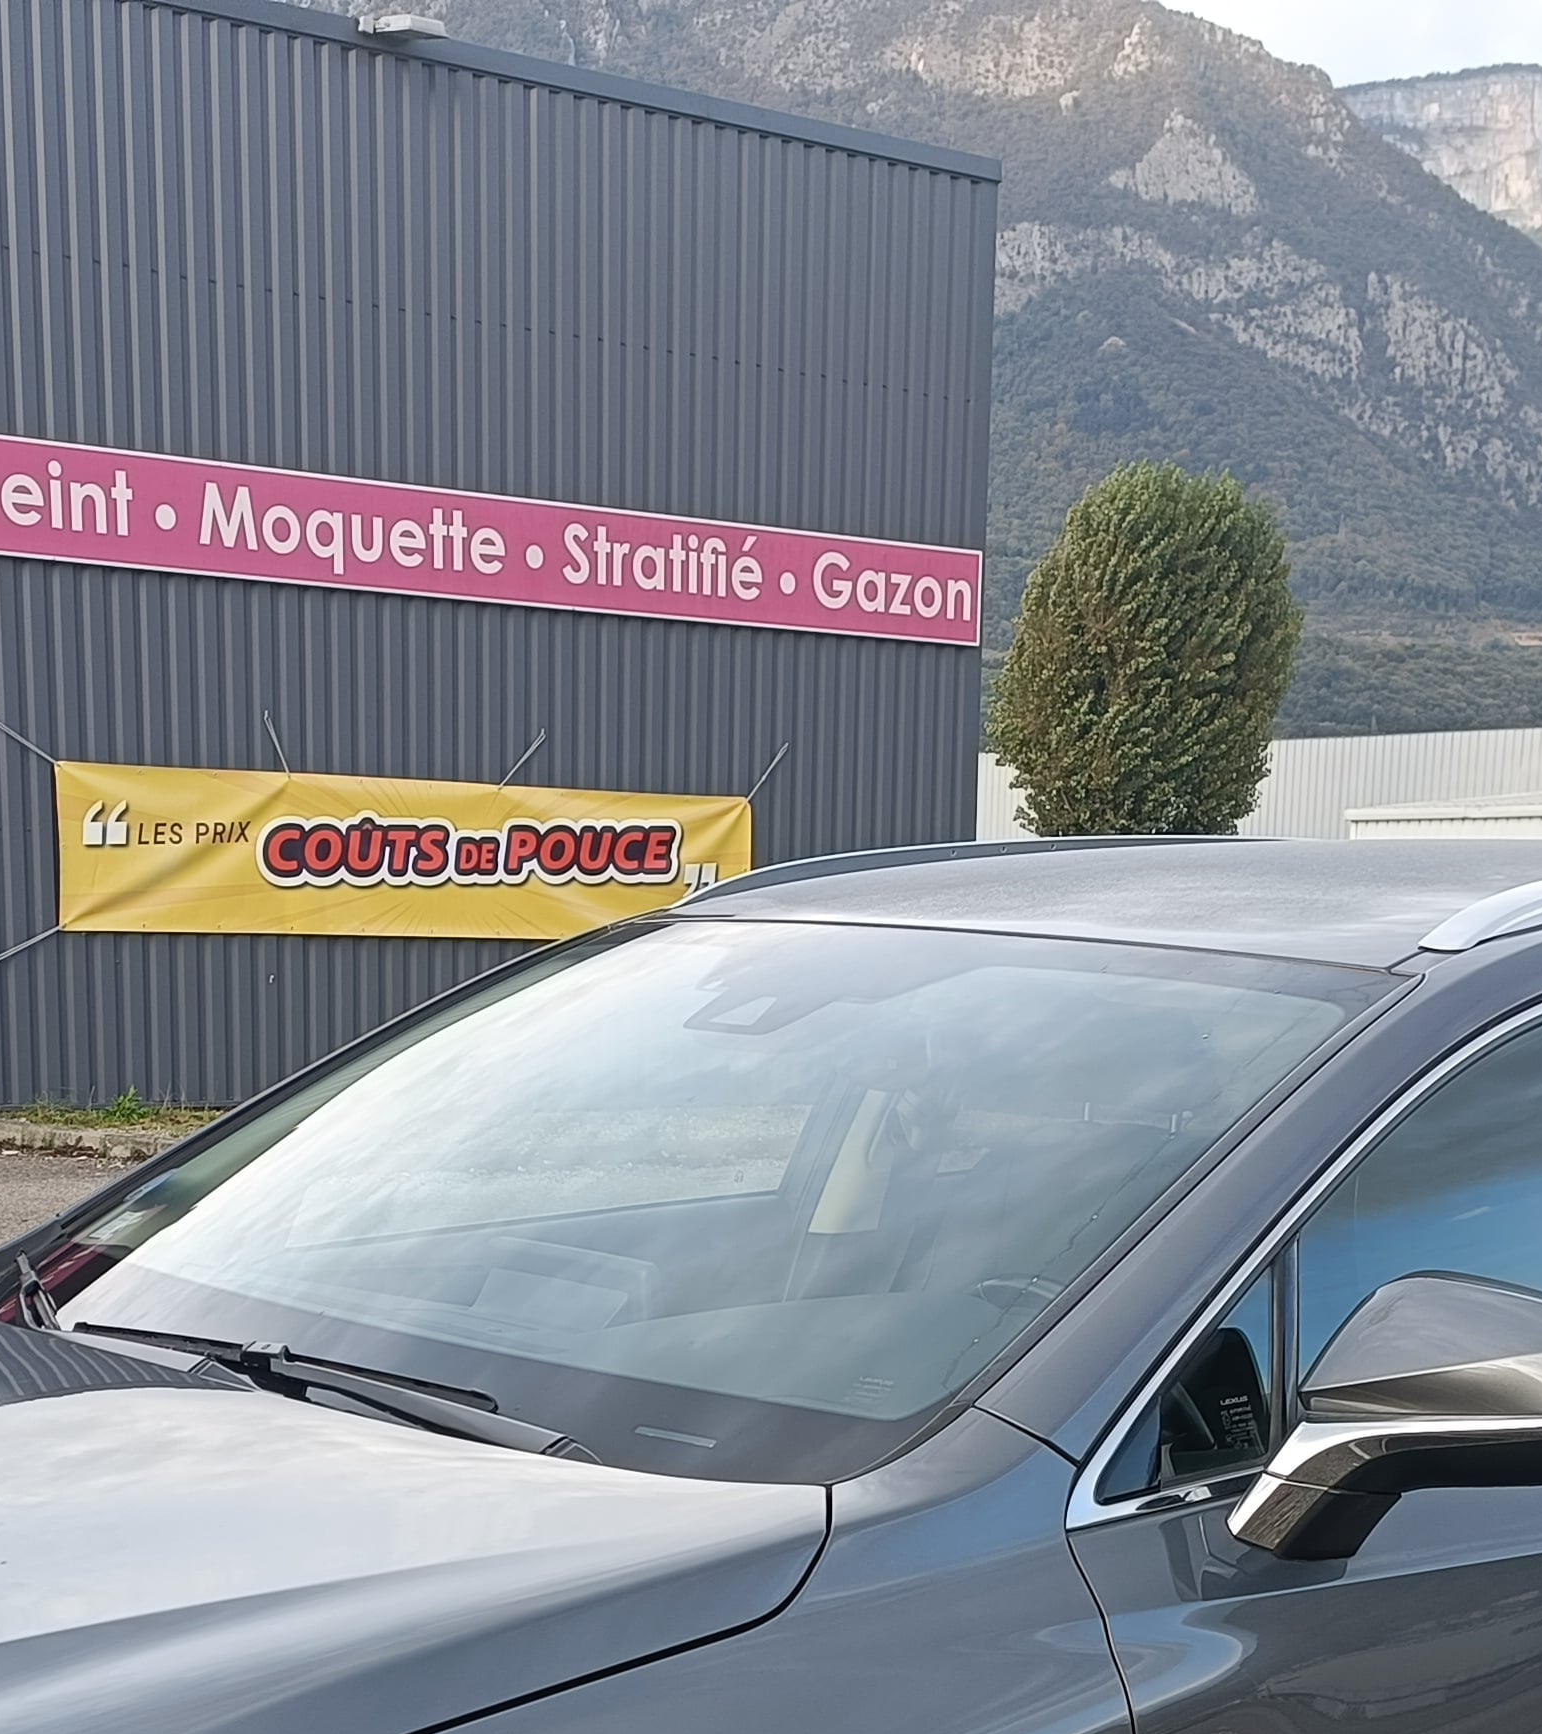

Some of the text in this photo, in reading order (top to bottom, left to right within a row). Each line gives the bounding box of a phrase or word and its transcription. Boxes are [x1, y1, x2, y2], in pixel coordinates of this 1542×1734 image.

[199, 482, 505, 575] Moquette
[563, 522, 762, 600] Stratifié
[813, 551, 972, 621] Gazon
[137, 819, 673, 876] LES PRIX COÛTS DE POUCE
